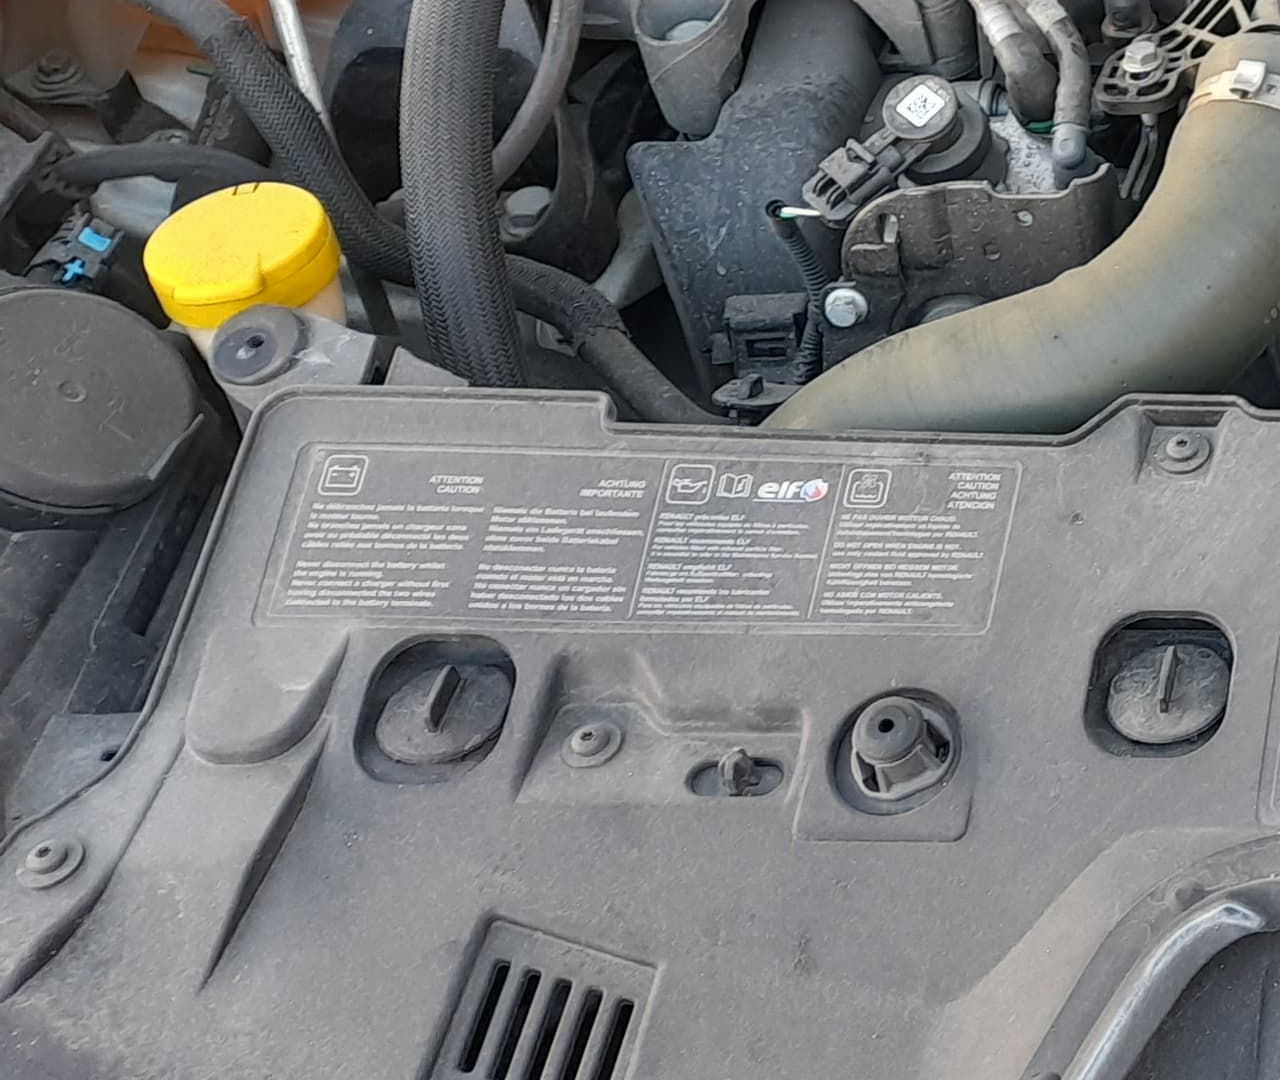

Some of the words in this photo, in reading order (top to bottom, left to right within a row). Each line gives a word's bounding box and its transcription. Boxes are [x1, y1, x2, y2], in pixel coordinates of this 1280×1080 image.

[429, 475, 484, 484] ATTENTION
[949, 472, 1001, 481] ATTENTION
[599, 479, 646, 488] ACHTUNG
[957, 482, 1000, 490] CAUTION
[437, 485, 481, 494] CAUTION
[579, 489, 644, 498] IMPORTANTE
[757, 481, 804, 499] elf
[950, 491, 996, 500] ACHTUNG
